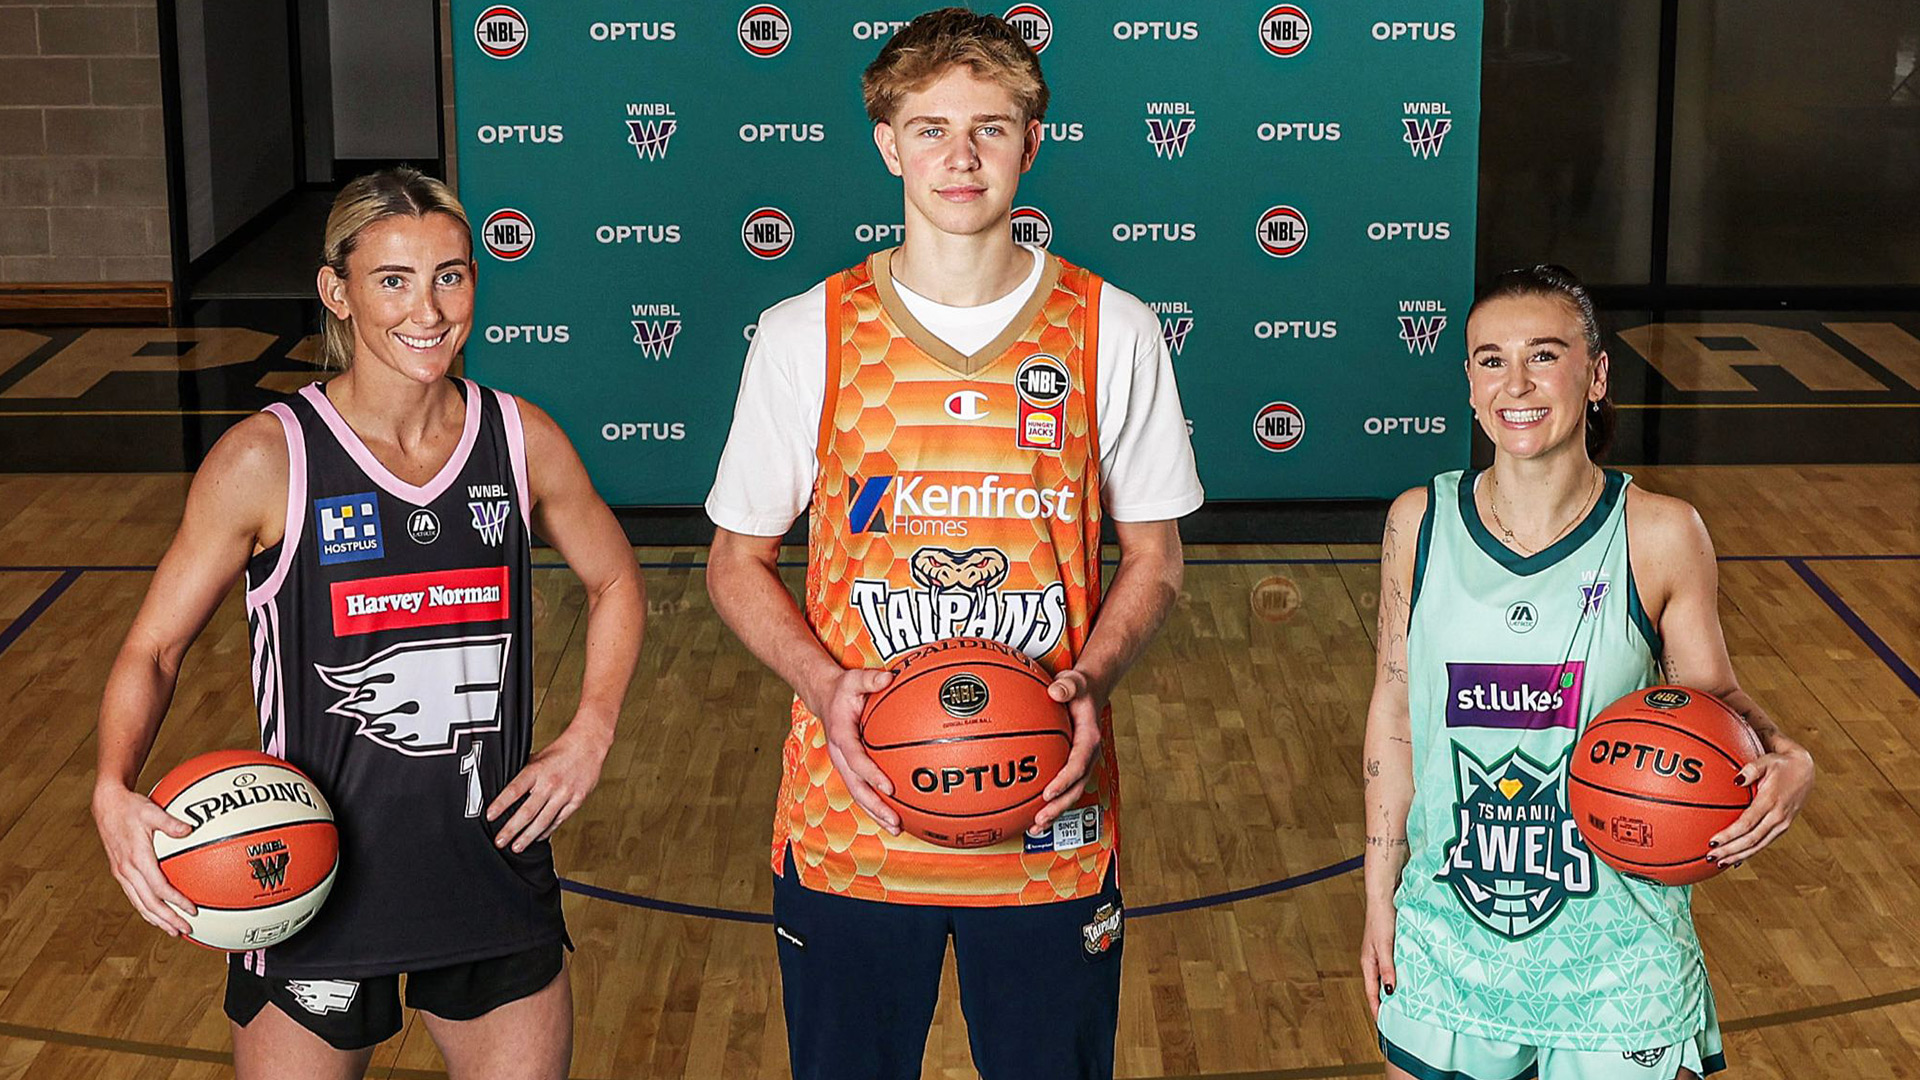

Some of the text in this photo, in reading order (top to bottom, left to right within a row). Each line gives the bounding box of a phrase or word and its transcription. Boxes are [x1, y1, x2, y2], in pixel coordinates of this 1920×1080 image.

[487, 21, 515, 42] NBL
[590, 22, 676, 41] OPTUS
[750, 20, 778, 41] NBL
[852, 21, 911, 40] OPT
[1113, 21, 1199, 40] OPTUS
[1271, 20, 1299, 41] NBL
[1371, 21, 1456, 41] OPTUS
[626, 103, 676, 116] WNBL
[1146, 102, 1195, 115] WNBL
[1403, 102, 1452, 115] WNBL
[477, 125, 564, 144] OPTUS
[739, 123, 825, 142] OPTUS
[1040, 123, 1084, 141] TUS
[1256, 122, 1341, 141] OPTUS
[494, 224, 521, 245] NBL
[595, 225, 681, 244] OPTUS
[754, 222, 782, 243] NBL
[855, 224, 906, 242] OPT
[1011, 222, 1040, 243] NBL
[1112, 223, 1196, 242] OPTUS
[1267, 221, 1295, 242] NBL
[1367, 222, 1450, 241] OPTUS
[631, 304, 681, 316] WNBL
[1399, 300, 1446, 312] WNBL
[485, 325, 570, 343] OPTUS
[1254, 321, 1337, 339] OPTUS
[1027, 369, 1058, 394] NBL
[601, 422, 686, 441] OPTUS
[1264, 416, 1292, 436] NBL
[1363, 416, 1446, 435] OPTUS
[467, 484, 509, 499] WNBL
[895, 475, 1075, 522] Kenfrost
[892, 516, 968, 536] Homes
[324, 539, 378, 555] HOSTPLUS
[346, 585, 500, 617] Harvey Norman
[851, 578, 1067, 663] TAIPANS
[892, 638, 1038, 675] PALDING
[950, 684, 979, 704] NBL
[1590, 739, 1704, 784] OPTUS
[460, 740, 483, 818] 1
[911, 755, 1039, 795] OPTUS
[1058, 821, 1079, 831] SINCE
[1061, 829, 1077, 838] 1919
